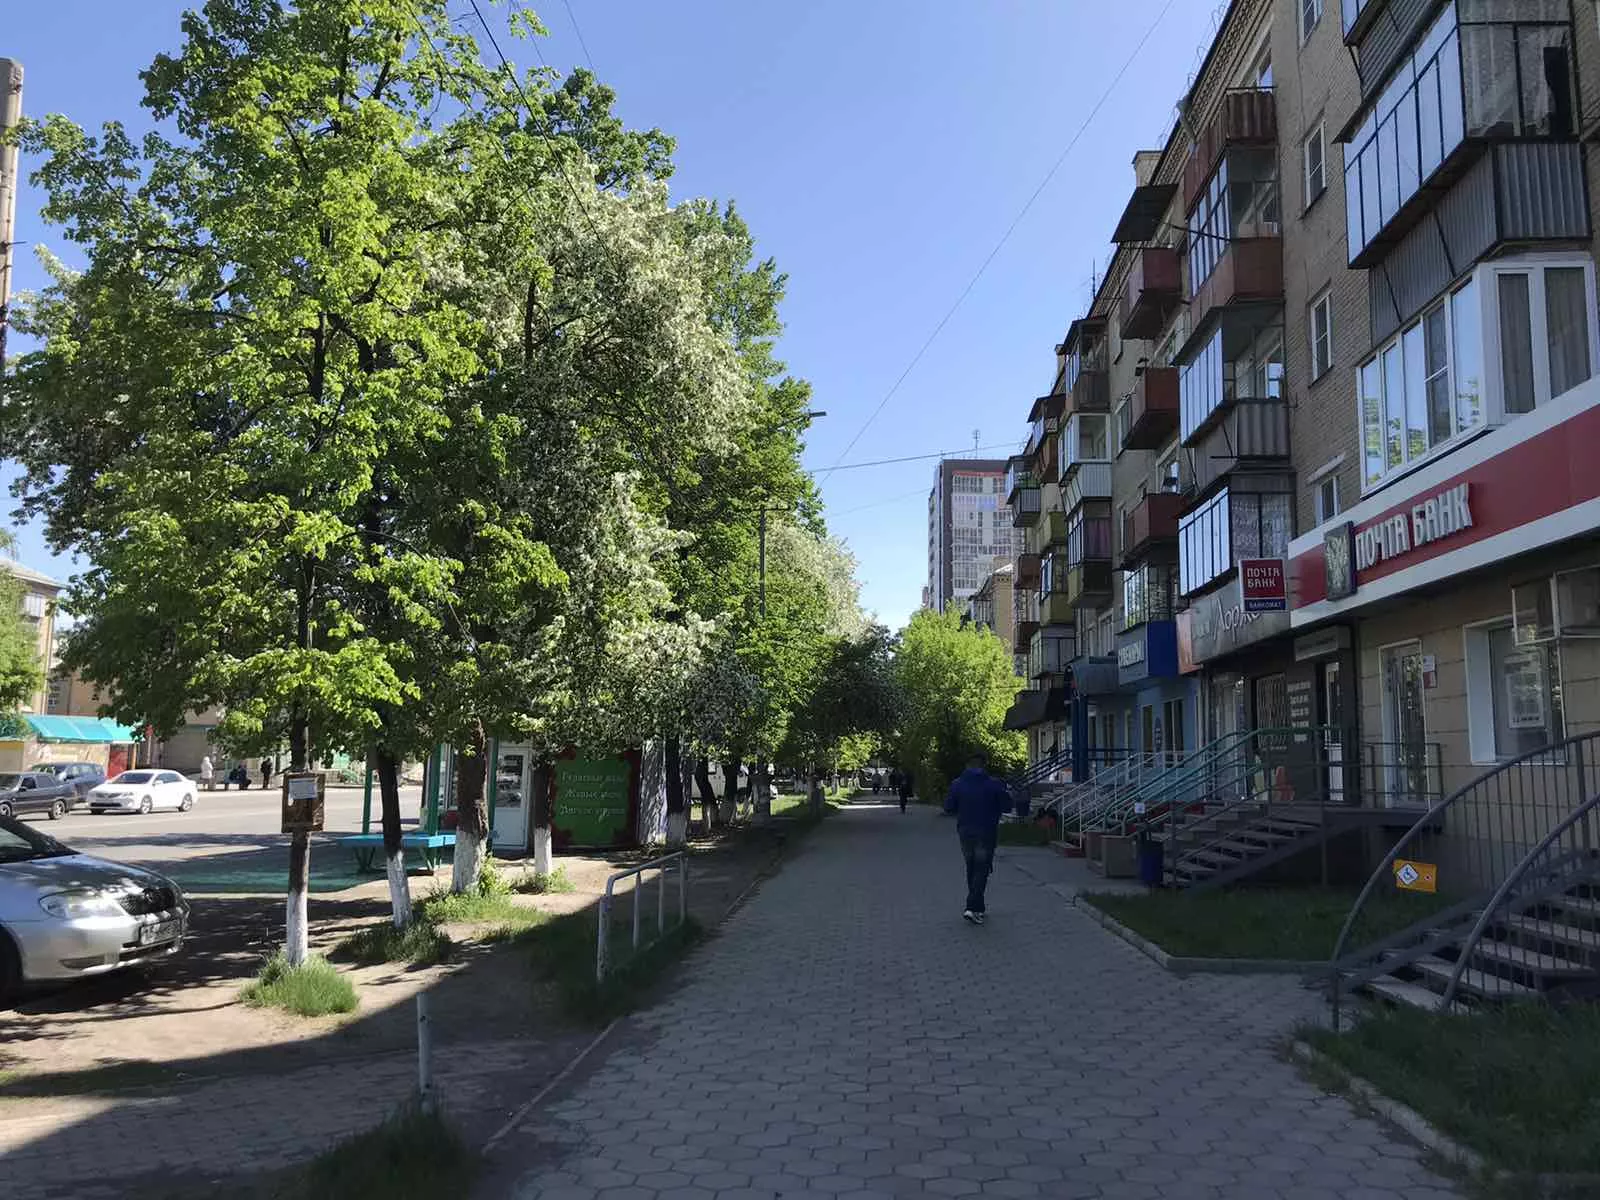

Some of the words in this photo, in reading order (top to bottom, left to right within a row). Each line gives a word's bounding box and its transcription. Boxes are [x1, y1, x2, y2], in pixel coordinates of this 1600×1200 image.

[1355, 513, 1411, 571] ПОЧТА
[1412, 482, 1473, 547] БАНК
[1247, 567, 1280, 578] ПОЧТА
[1247, 577, 1276, 588] БАНК
[1249, 601, 1281, 609] БАНКОМАТ
